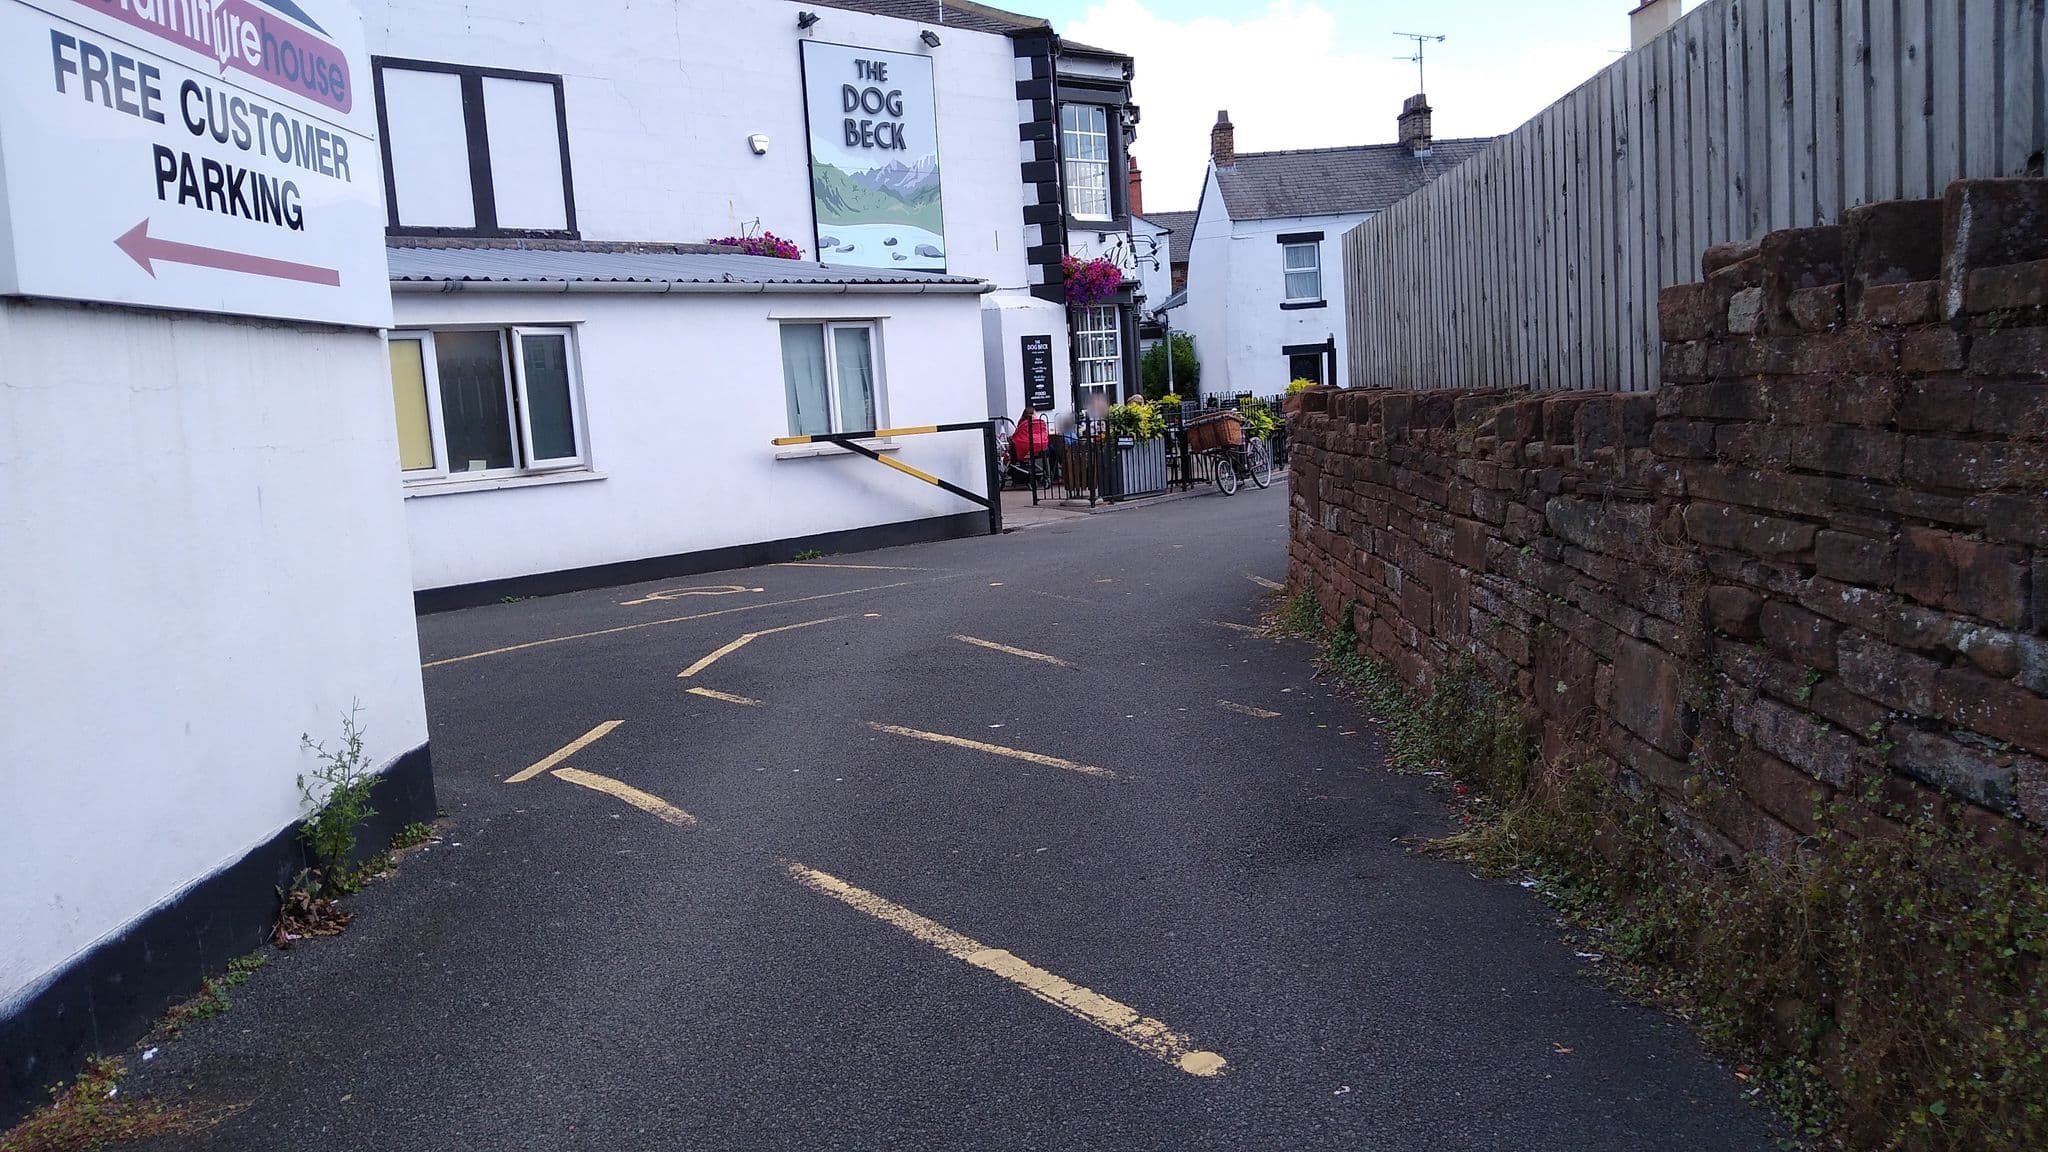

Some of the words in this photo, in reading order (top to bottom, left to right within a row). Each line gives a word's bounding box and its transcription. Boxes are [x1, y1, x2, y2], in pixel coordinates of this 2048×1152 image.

[855, 58, 888, 81] THE
[50, 29, 165, 124] FREE
[180, 79, 351, 182] CUSTOMER
[843, 84, 903, 117] DOG
[844, 118, 906, 150] BECK
[153, 143, 304, 231] PARKING
